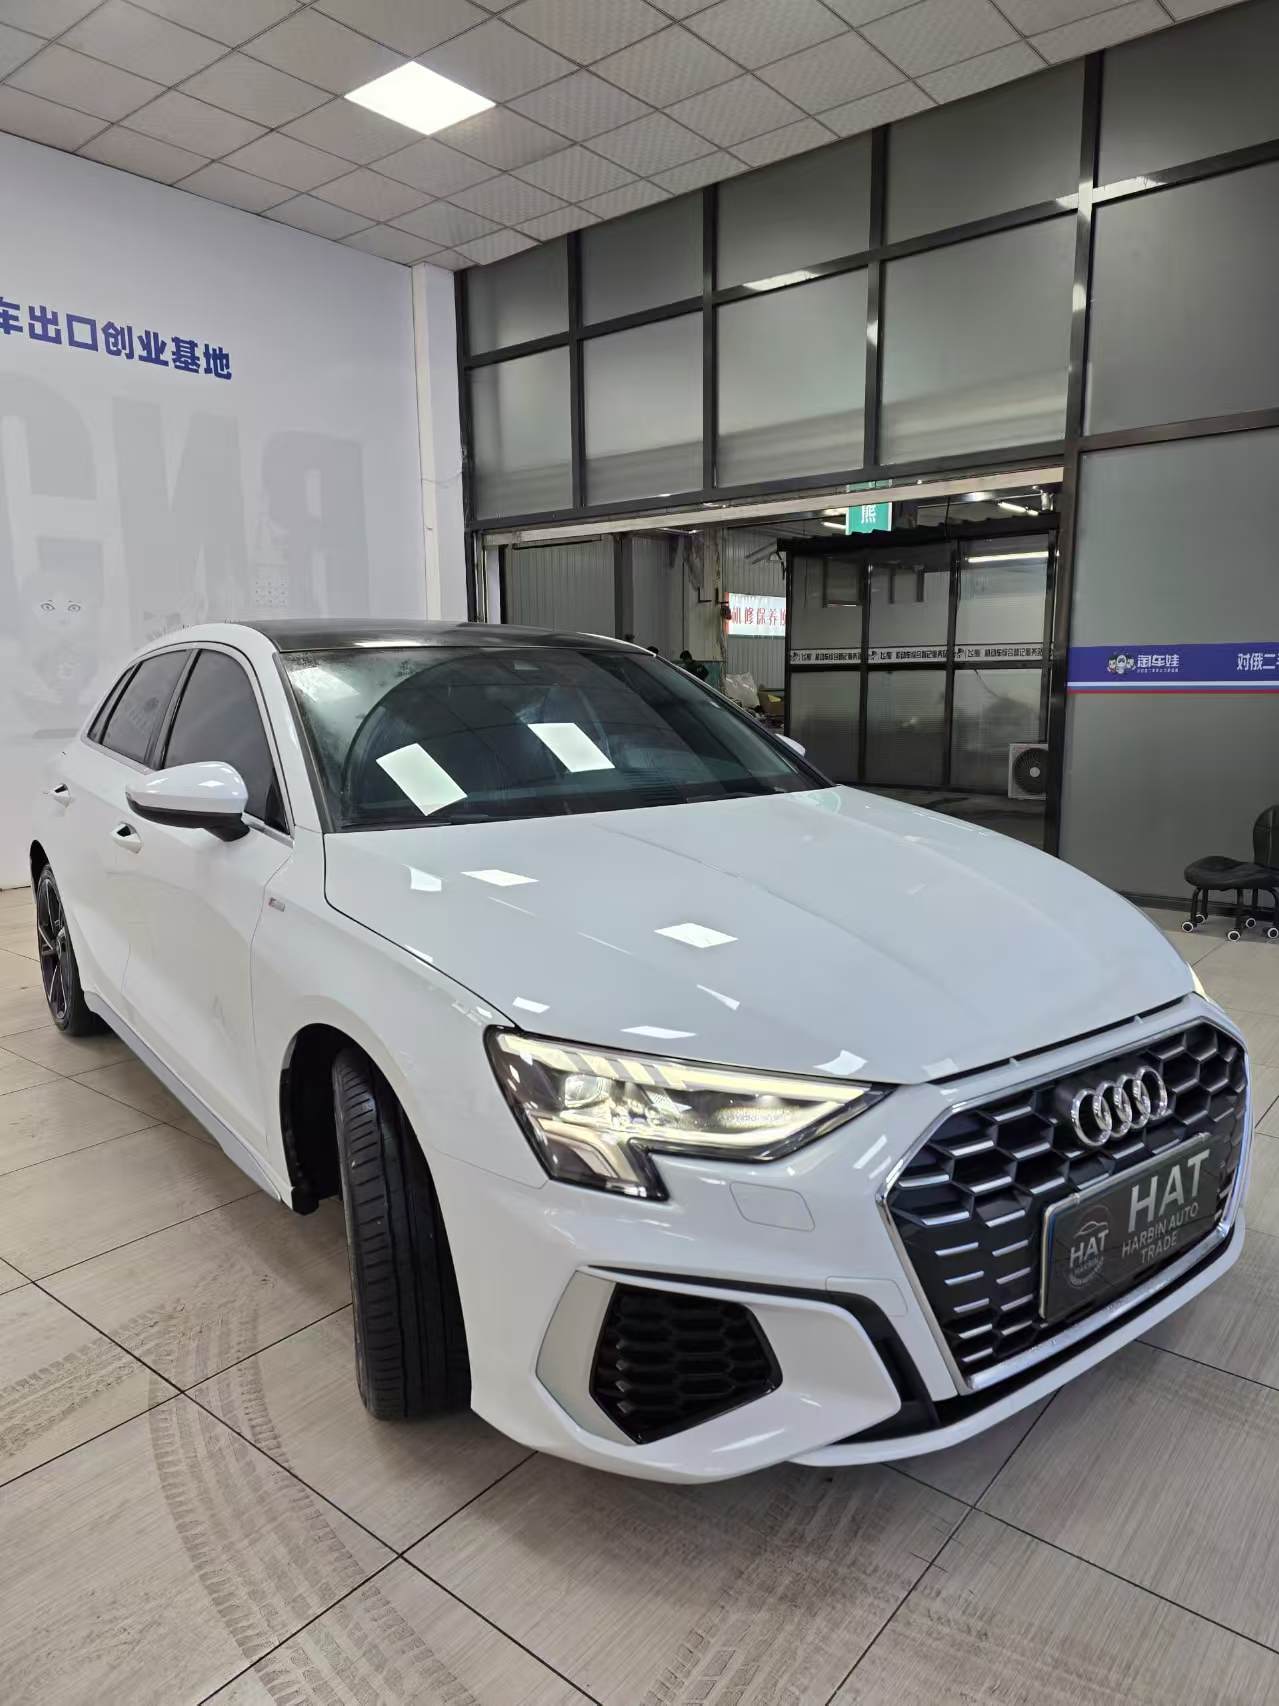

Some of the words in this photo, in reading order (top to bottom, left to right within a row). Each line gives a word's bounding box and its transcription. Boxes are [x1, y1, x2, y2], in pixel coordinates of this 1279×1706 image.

[0, 297, 232, 380] 车出口创业基地
[1128, 1149, 1210, 1233] HAT
[1070, 1229, 1109, 1268] HAT
[1122, 1219, 1167, 1258] HARBIN
[1168, 1202, 1199, 1231] AUTO
[1141, 1230, 1178, 1264] TRADE
